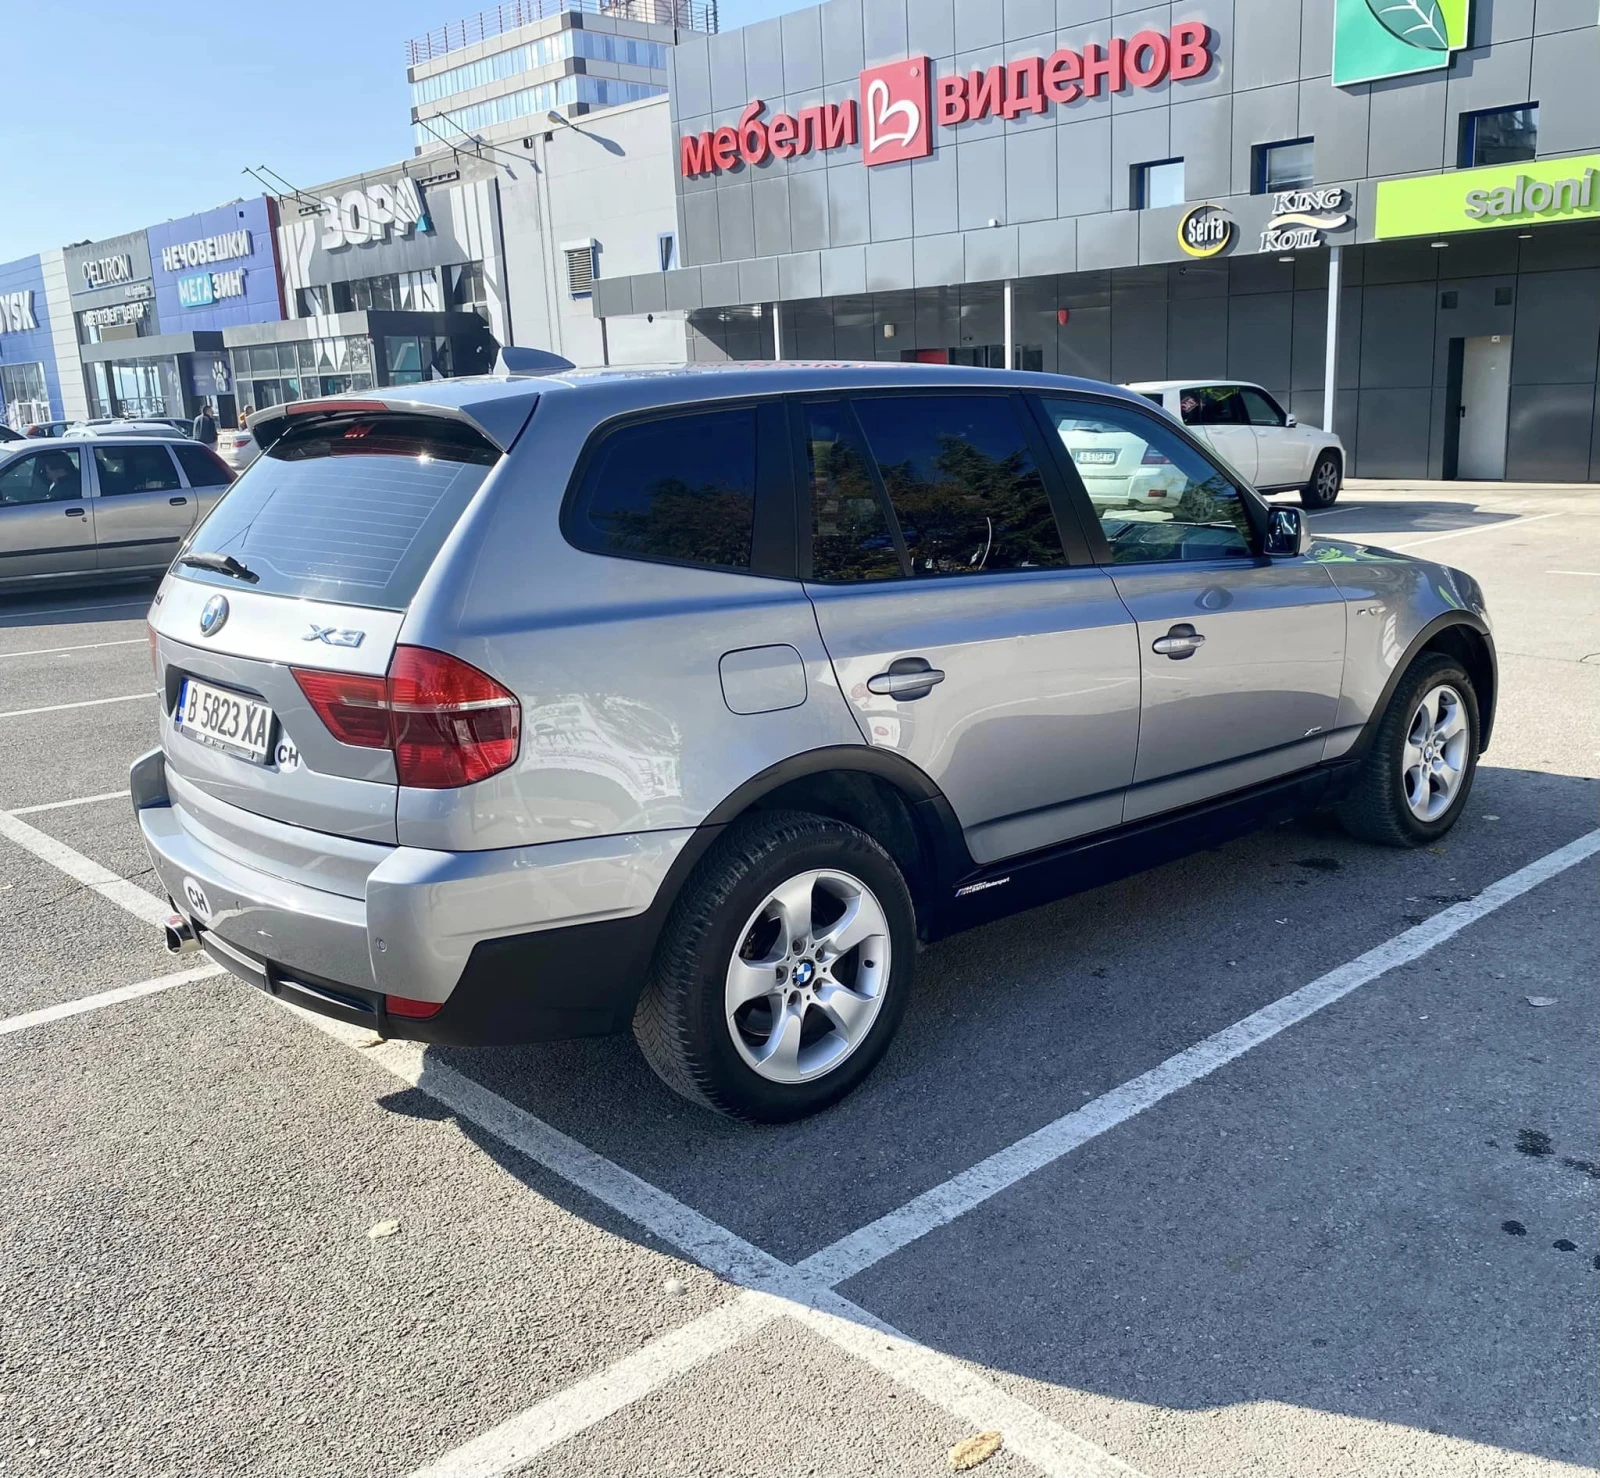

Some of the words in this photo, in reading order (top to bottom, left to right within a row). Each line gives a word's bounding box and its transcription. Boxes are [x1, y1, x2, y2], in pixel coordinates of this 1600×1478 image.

[681, 100, 857, 177] мебели
[937, 21, 1212, 127] виденов
[321, 177, 430, 250] ЗОРА
[1271, 188, 1343, 215] KING
[1188, 217, 1225, 243] Serta
[1259, 228, 1322, 253] KOIL
[162, 229, 250, 272] НЕЧОВЕШКИ
[0, 290, 36, 334] YSK
[300, 624, 366, 648] X3
[187, 688, 199, 723] B
[200, 693, 240, 738] 5823
[242, 704, 267, 749] XA
[277, 744, 299, 767] CH
[187, 885, 210, 915] CH
